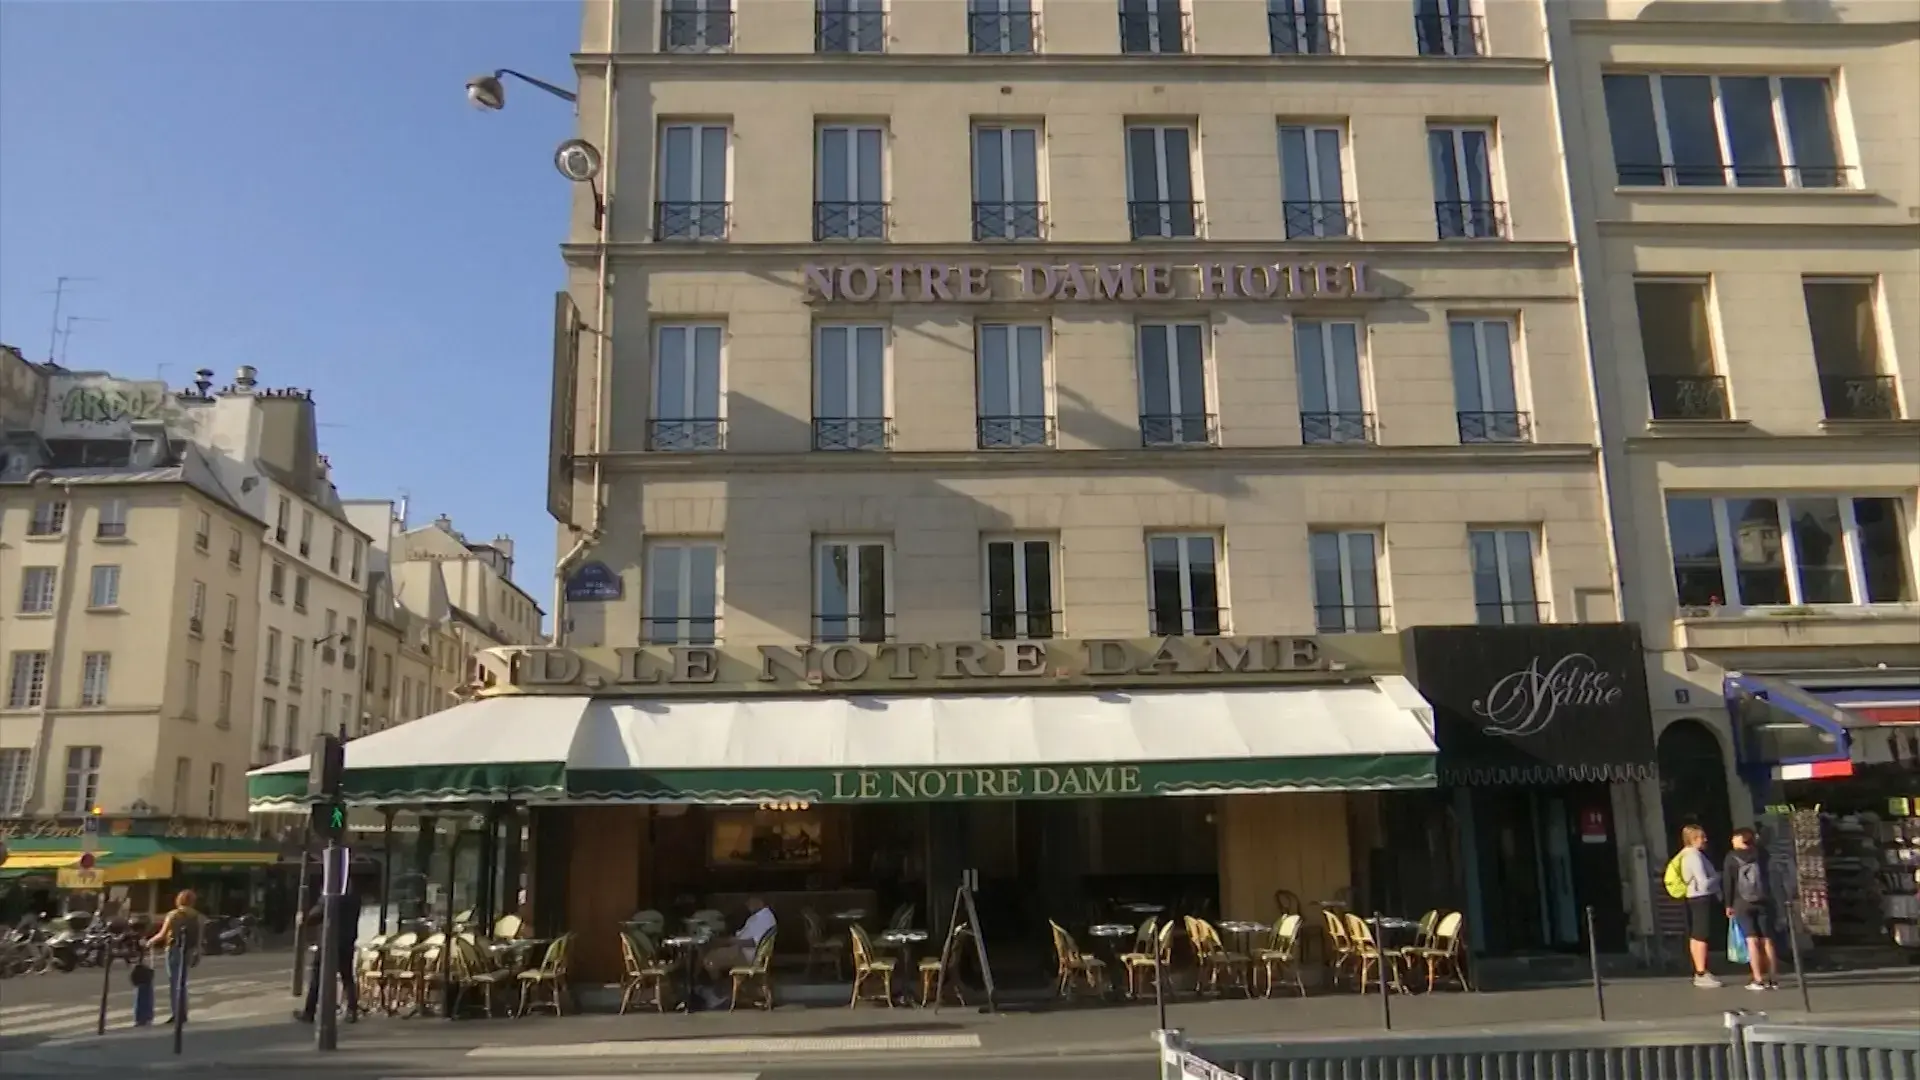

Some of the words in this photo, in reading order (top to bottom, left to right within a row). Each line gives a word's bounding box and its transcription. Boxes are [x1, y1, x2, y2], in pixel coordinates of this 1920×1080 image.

[803, 262, 993, 303] NOTRE
[1020, 261, 1174, 301] DAME
[1198, 260, 1383, 299] HOTEL
[615, 646, 720, 685] LE
[757, 638, 1048, 684] NOTRE
[1081, 634, 1324, 677] DAME
[831, 772, 883, 799] LE
[889, 769, 1025, 799] NOTRE
[1031, 766, 1142, 796] DAME
